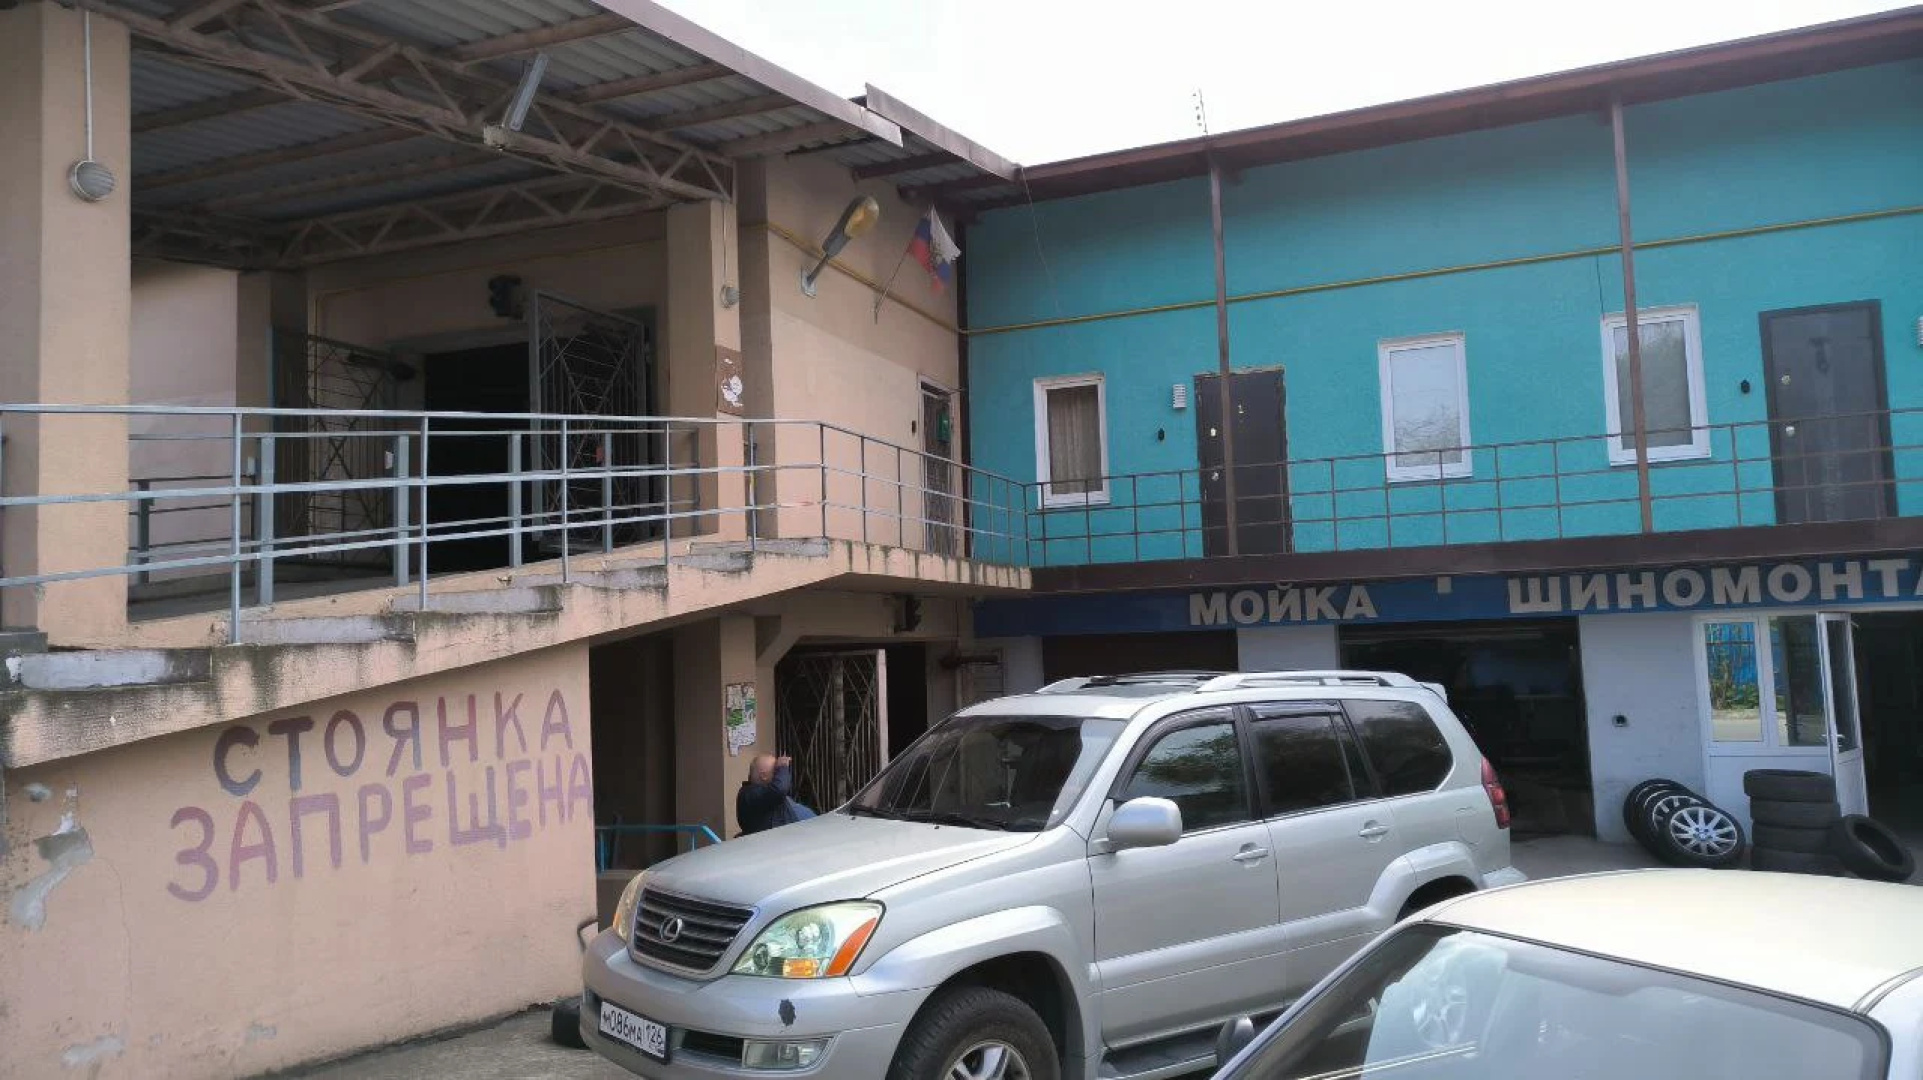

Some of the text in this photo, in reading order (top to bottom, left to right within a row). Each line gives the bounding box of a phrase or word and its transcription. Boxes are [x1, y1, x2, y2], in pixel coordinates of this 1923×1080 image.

[1189, 559, 1923, 625] МОЙКА ШИНОМОНТ
[213, 688, 573, 797] СТОЯНКА
[167, 753, 594, 902] ЗАПРЕЩЕНА
